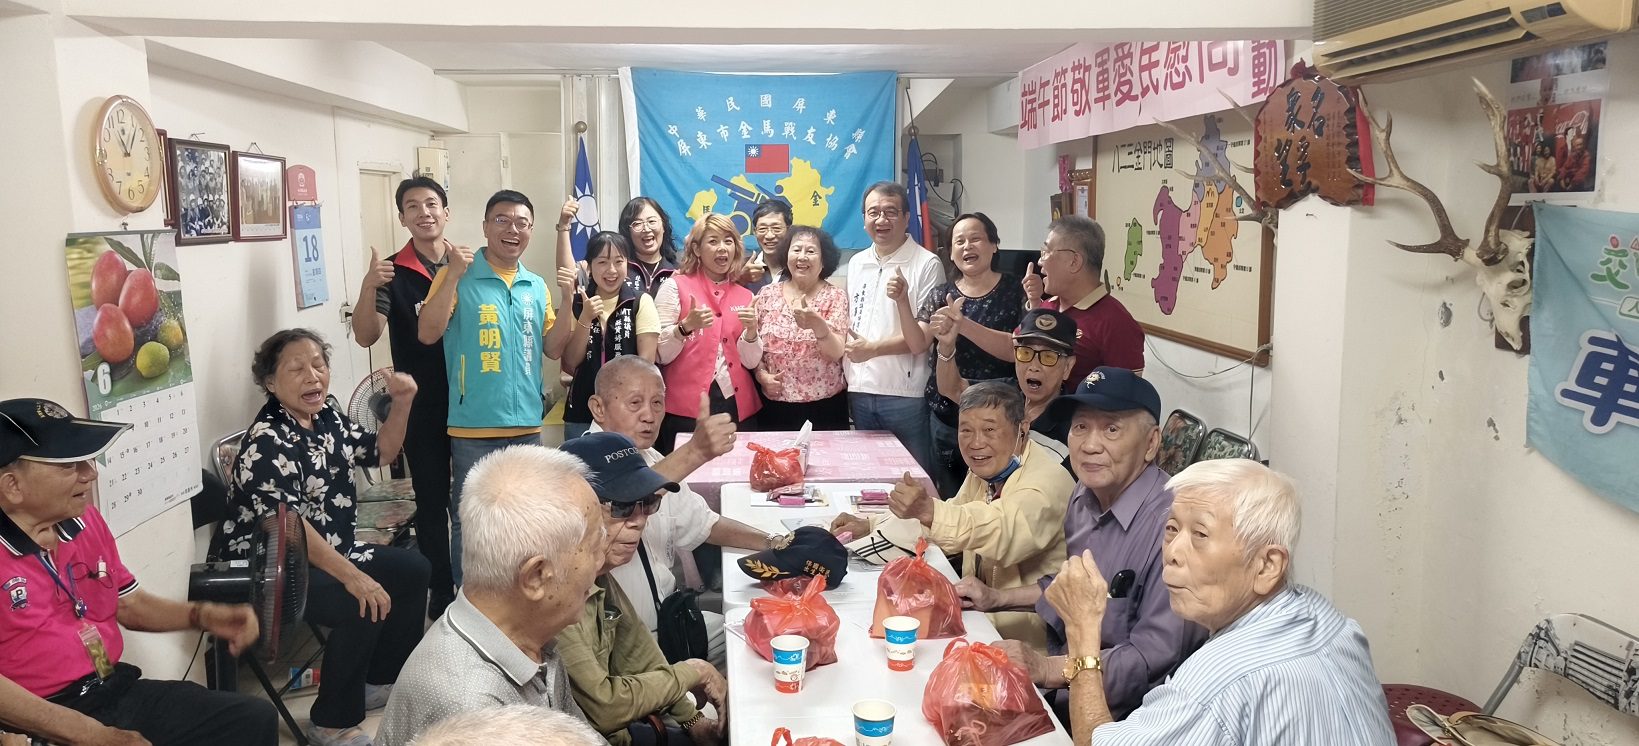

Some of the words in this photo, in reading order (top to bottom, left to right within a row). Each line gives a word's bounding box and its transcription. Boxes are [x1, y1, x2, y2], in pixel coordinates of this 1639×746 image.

[116, 109, 126, 124] 12
[139, 127, 145, 142] 2
[677, 120, 858, 160] 屏東市金馬戰友協會
[1112, 138, 1174, 173] 八二三金門地圖
[115, 181, 122, 195] 7
[128, 186, 135, 200] 6
[137, 180, 144, 194] 5
[810, 190, 822, 207] 金
[303, 234, 319, 262] 18
[478, 304, 502, 374] 黃明賢
[522, 307, 534, 376] 屏東縣議員
[97, 361, 112, 395] 6
